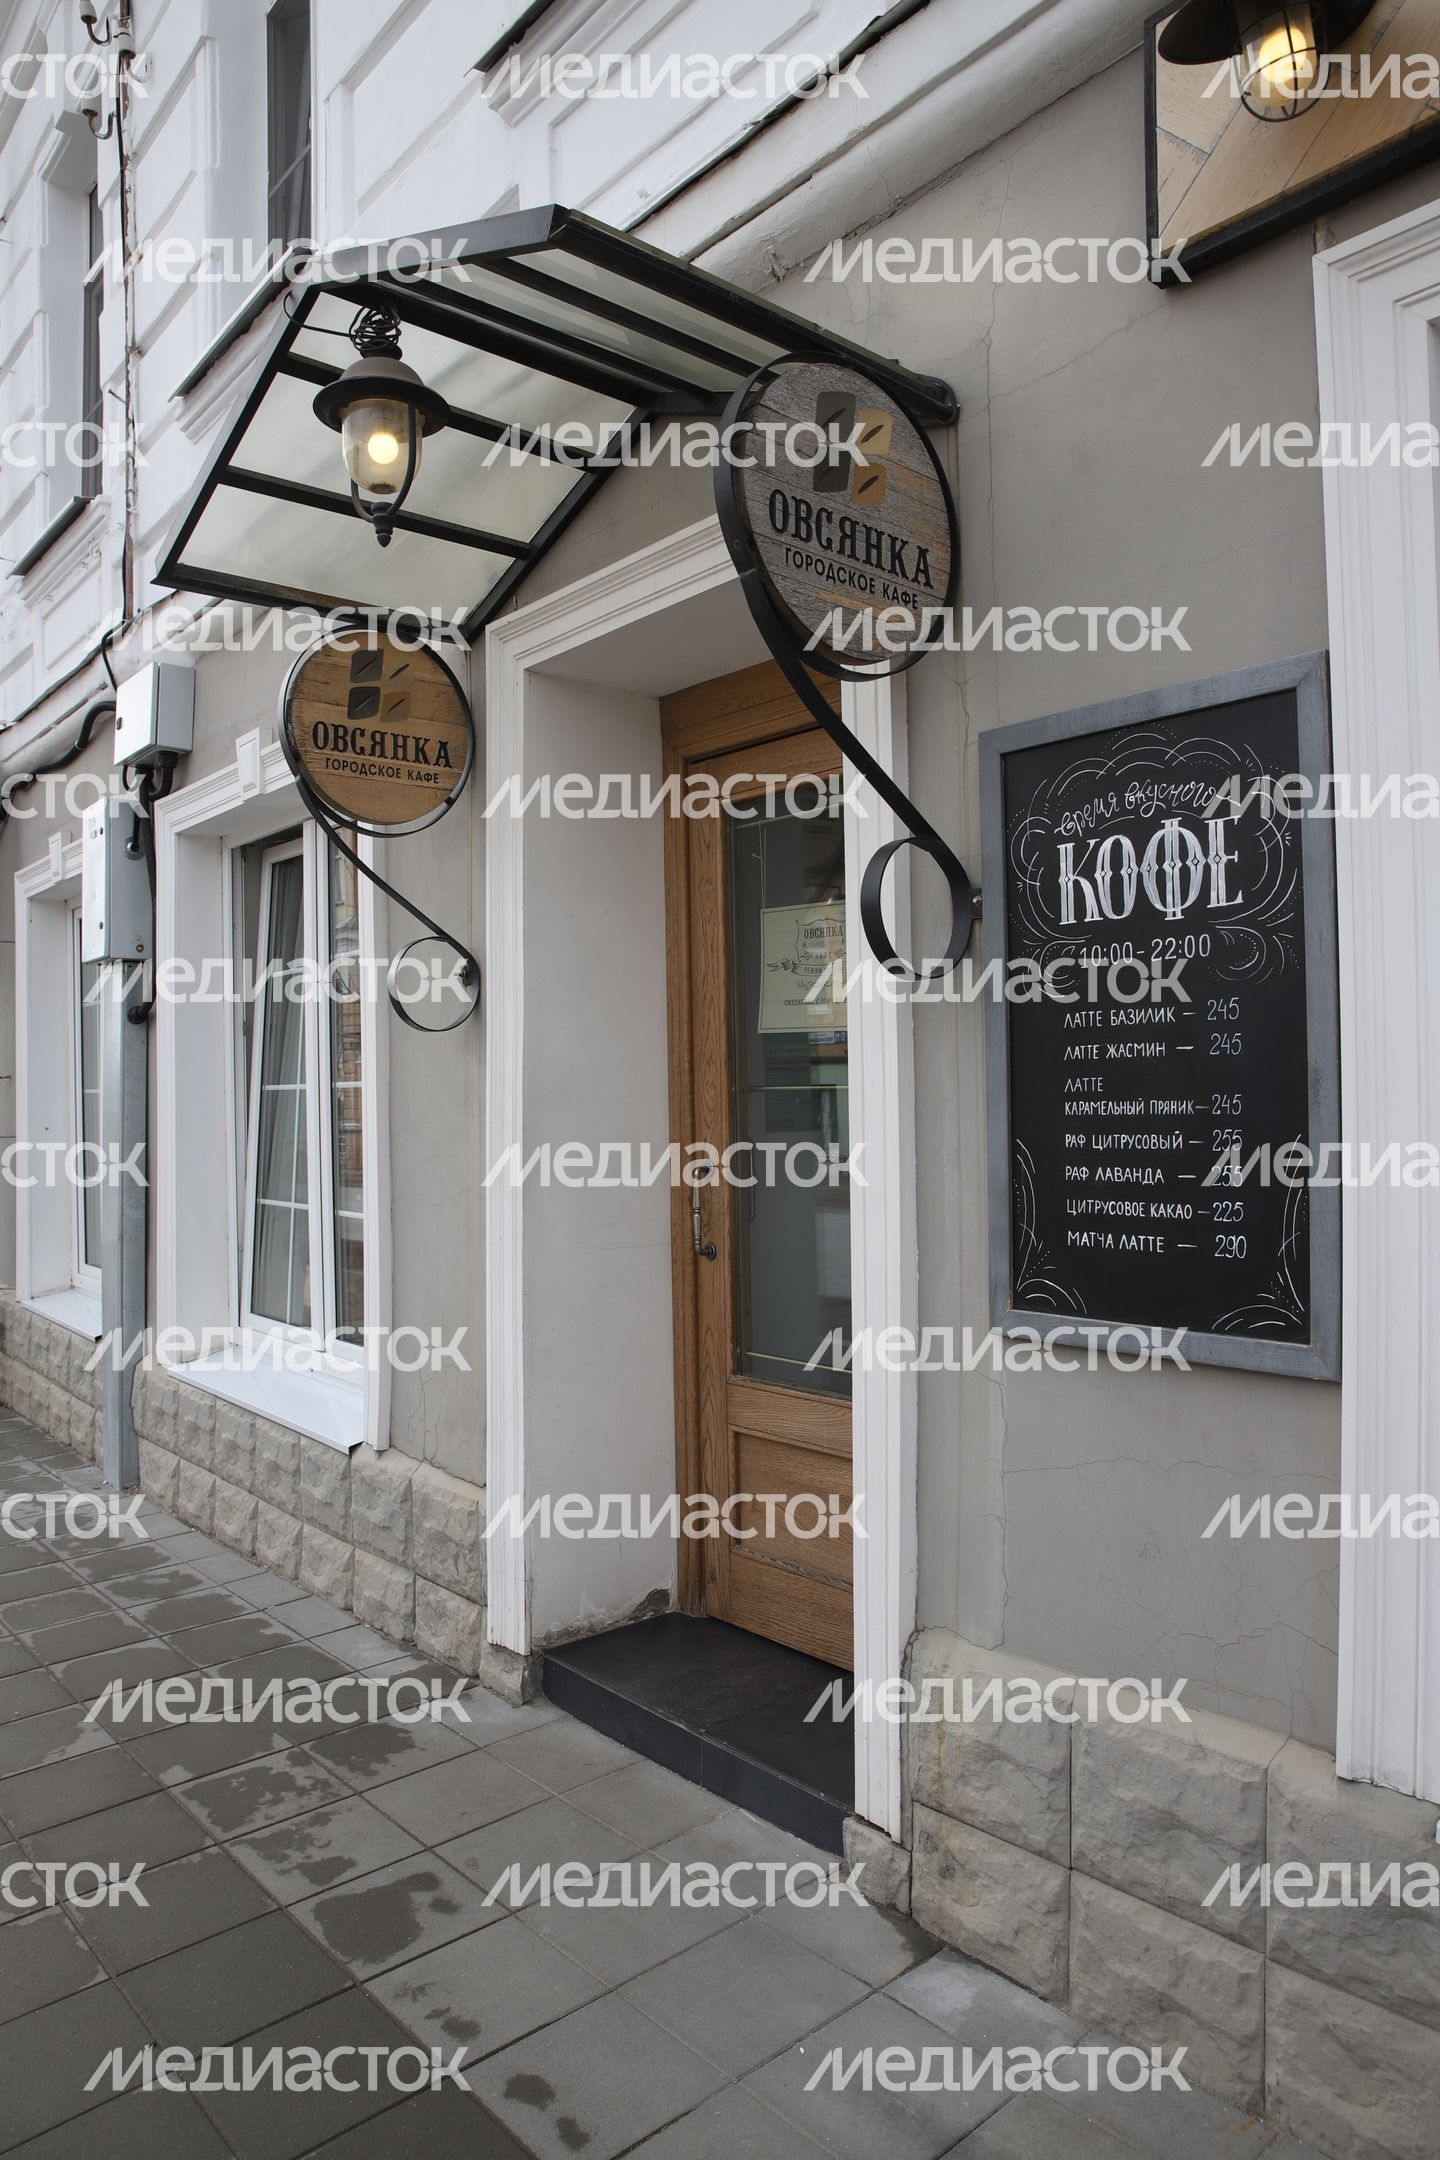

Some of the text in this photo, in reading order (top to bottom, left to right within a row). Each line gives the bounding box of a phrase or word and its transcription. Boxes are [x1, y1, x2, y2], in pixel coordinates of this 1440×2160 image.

[769, 489, 933, 590] ОВСЯНКА
[785, 547, 918, 610] ГОРОДСКОЕ КАФЕ
[312, 721, 452, 769] ОВСЯНКА
[326, 758, 439, 784] ГОРОДСКОЕ КАФЕ
[1054, 779, 1240, 837] время вкусного
[1056, 816, 1243, 924] КОФЕ
[803, 925, 844, 939] ОВСЯНКА
[1080, 941, 1133, 968] 10:00
[1151, 934, 1211, 961] 22:00
[1064, 1011, 1102, 1028] ЛАТТЕ
[1111, 1007, 1175, 1026] БАЗИЛИК
[1208, 997, 1239, 1020] 245
[1064, 1045, 1099, 1060] ЛАТТЕ
[1106, 1042, 1165, 1059] ЖАСМИН
[1210, 1033, 1241, 1055] 245
[1065, 1077, 1103, 1092] ЛАТТЕ
[1065, 1098, 1144, 1115] КАРАМЕЛЬНЫЙ
[1150, 1100, 1194, 1114] ПРЯНИК
[1212, 1094, 1241, 1114] 245
[1066, 1134, 1086, 1148] РАФ
[1093, 1131, 1182, 1151] ЦИТРУСОВЫЙ
[1212, 1129, 1243, 1152] 255
[1066, 1166, 1089, 1180] РАФ
[1096, 1167, 1164, 1185] ЛАВАНДА
[1211, 1166, 1243, 1187] 255
[1067, 1199, 1145, 1216] ЦИТРУСОВОЕ
[1151, 1203, 1192, 1219] КАКАО
[1213, 1201, 1243, 1222] 225
[1068, 1231, 1114, 1248] МАТЧА
[1119, 1234, 1164, 1252] ЛАТТЕ
[1215, 1235, 1246, 1258] 290
